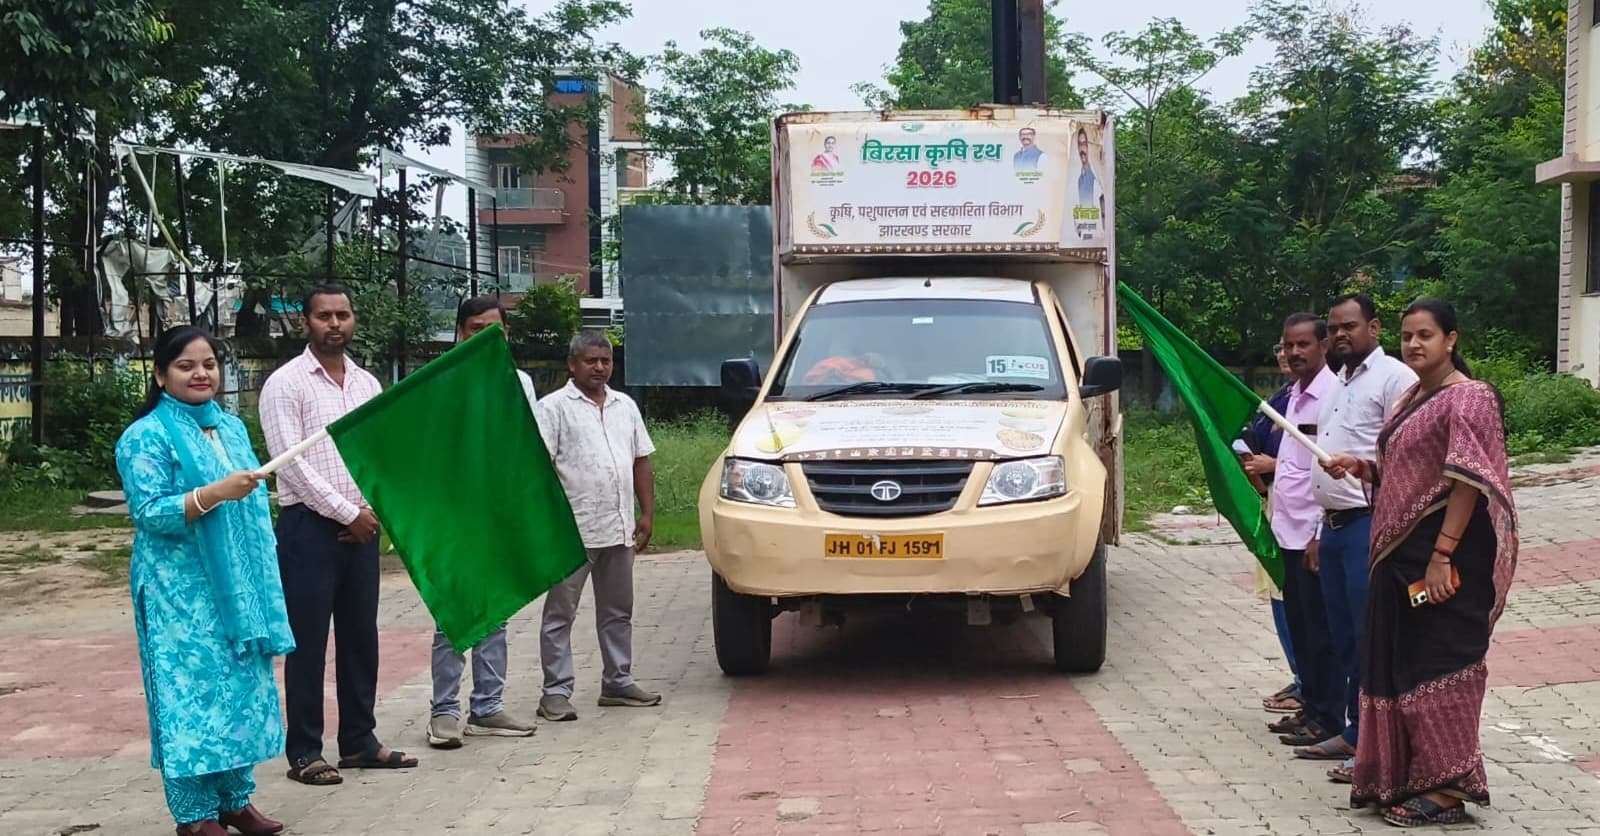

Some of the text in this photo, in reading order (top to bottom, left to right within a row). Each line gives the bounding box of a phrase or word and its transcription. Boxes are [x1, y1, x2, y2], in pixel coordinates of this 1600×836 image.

[862, 138, 1003, 167] बिरसा कृषि रथ
[906, 170, 957, 186] 2026
[830, 201, 1024, 222] कृषि, पशुपालन एवं सहकारिता विभाग
[879, 224, 973, 238] झारखण्ड सरकार
[988, 359, 1006, 373] 15
[1010, 359, 1045, 370] CUS
[828, 541, 940, 554] JH 01 FJ 1591
